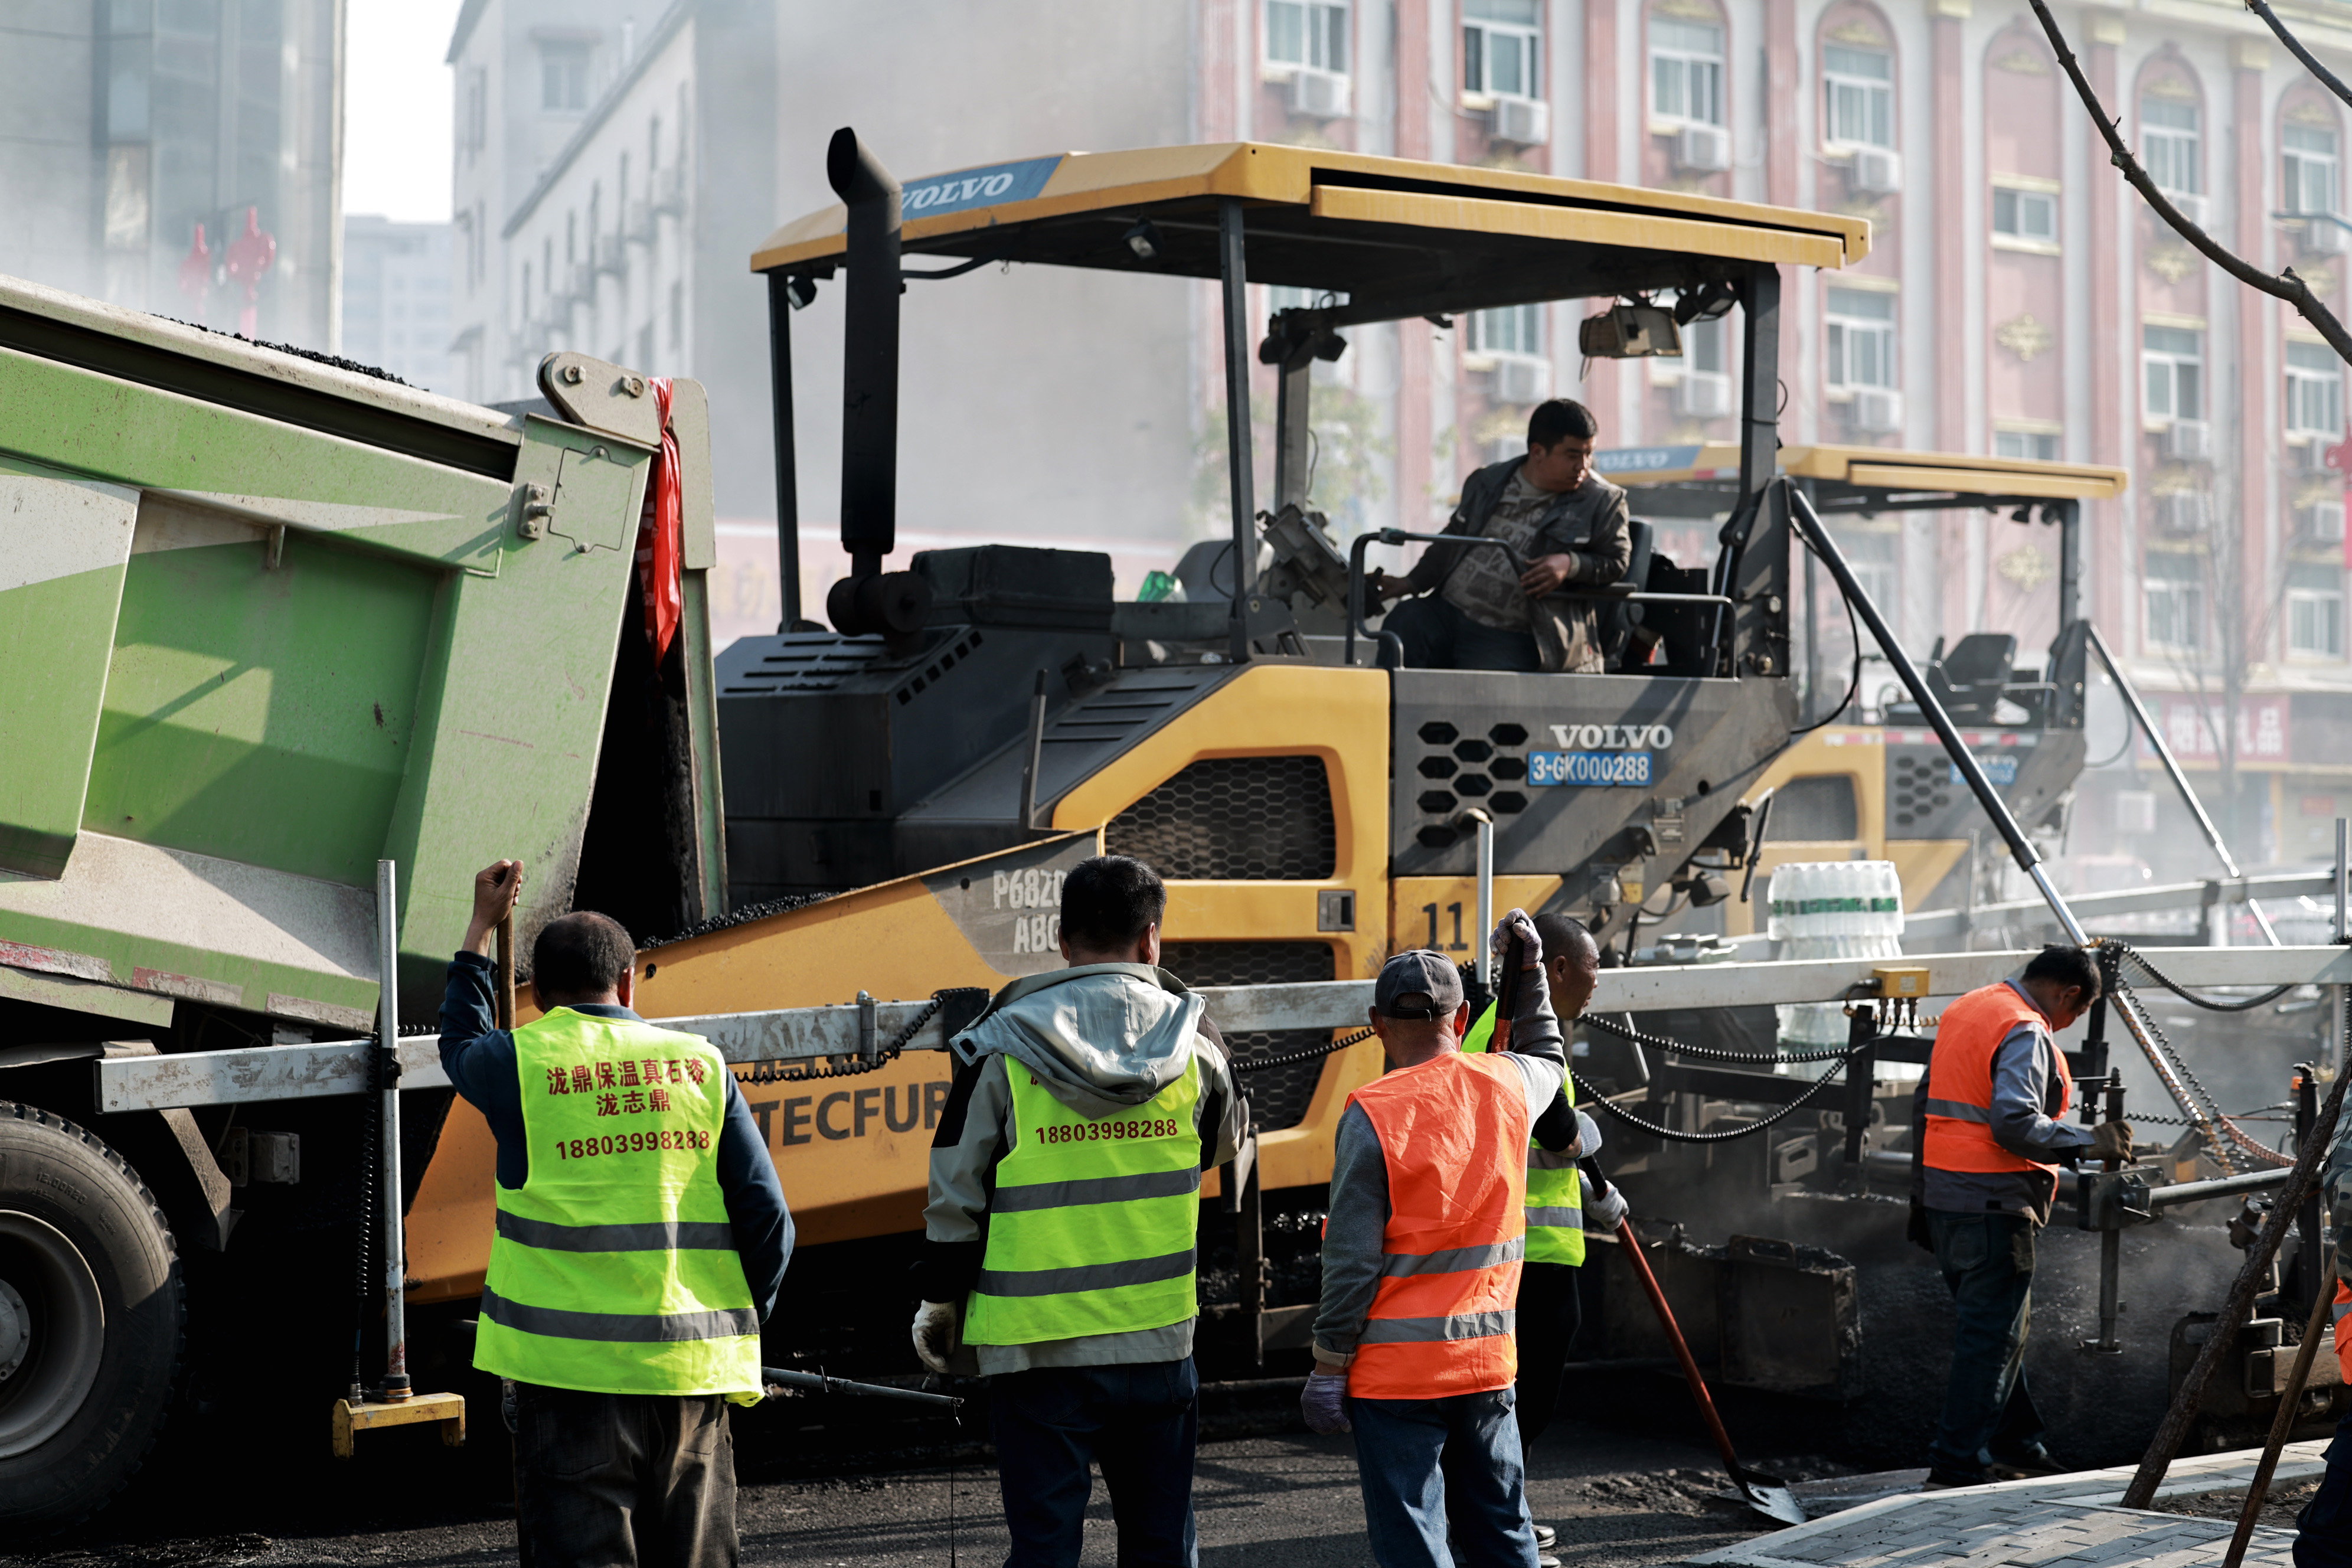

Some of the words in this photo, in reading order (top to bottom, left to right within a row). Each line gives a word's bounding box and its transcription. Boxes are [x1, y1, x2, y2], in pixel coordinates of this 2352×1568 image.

[1549, 724, 1674, 750] VOLVO
[1533, 754, 1649, 782] 3-GK000288
[1422, 901, 1468, 952] 11
[547, 1057, 705, 1096] 泷鼎保温真石漆
[596, 1089, 671, 1116] 泷志鼎
[556, 1131, 710, 1160] 18803998288
[1035, 1119, 1178, 1144] 18803998288
